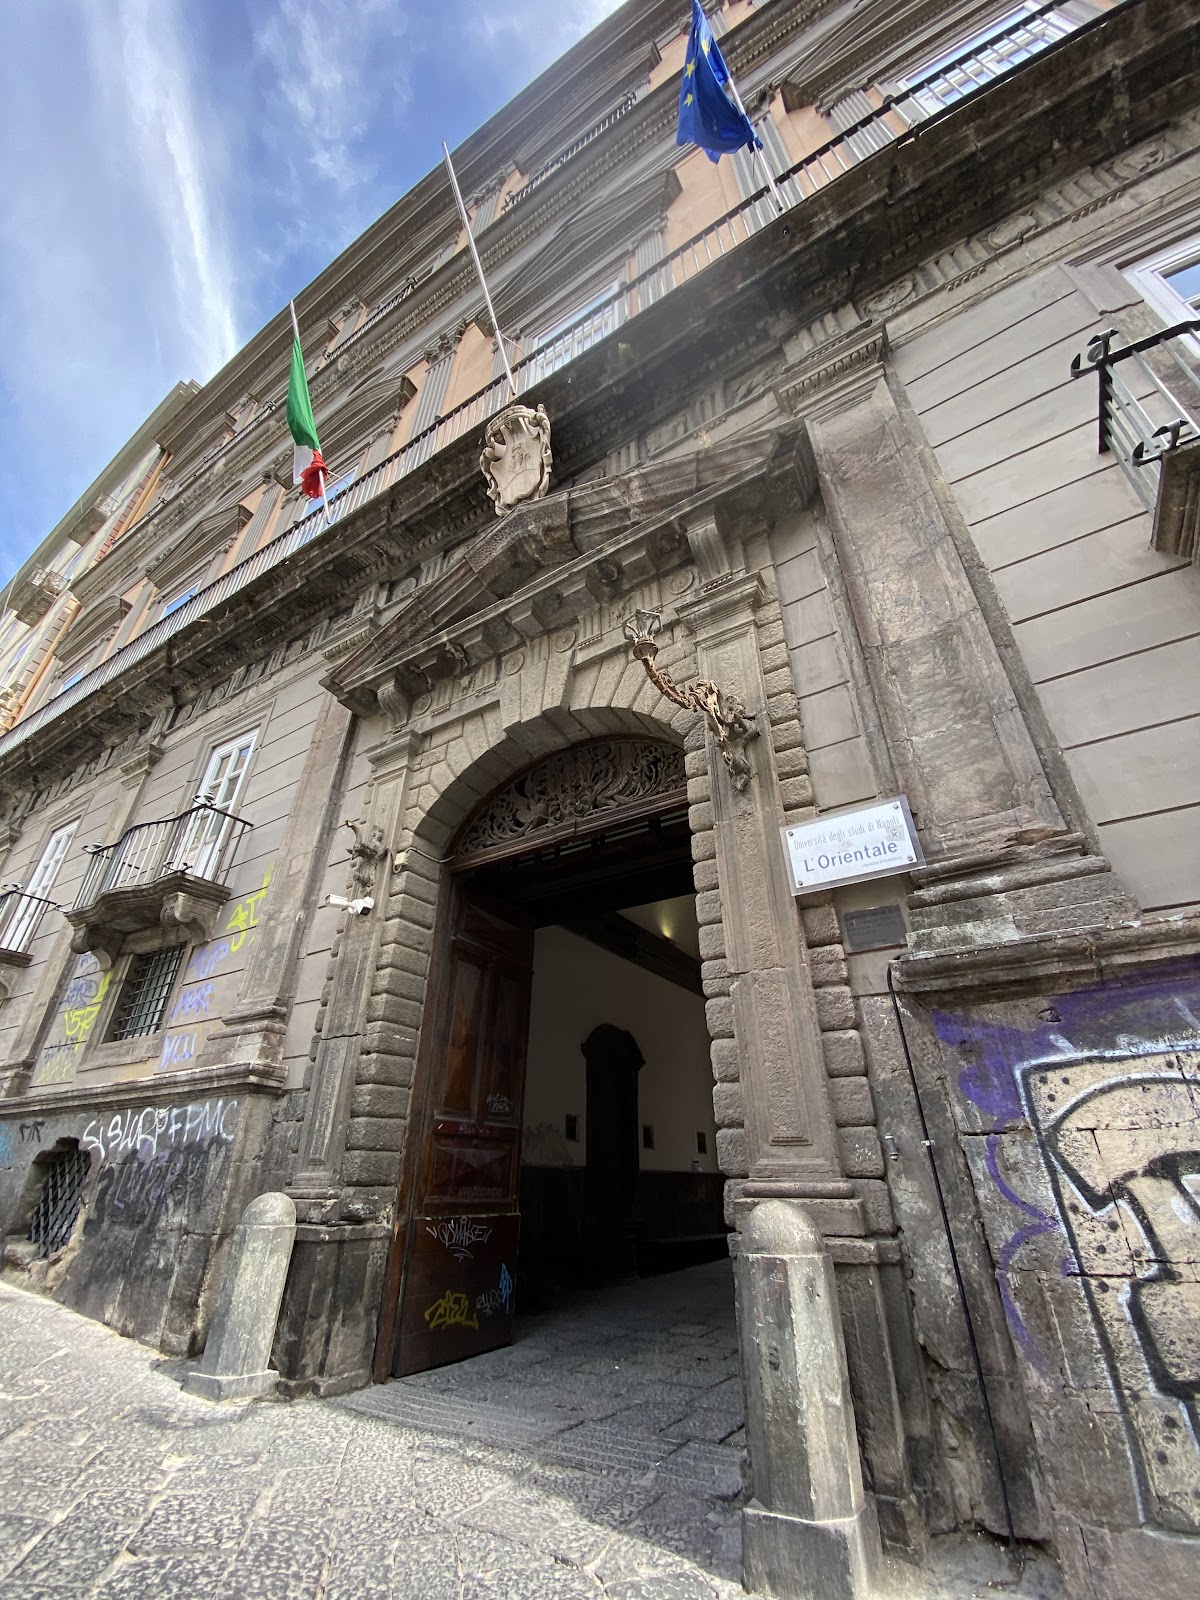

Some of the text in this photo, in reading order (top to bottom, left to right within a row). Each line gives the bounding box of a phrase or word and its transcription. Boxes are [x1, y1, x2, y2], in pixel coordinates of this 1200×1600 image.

[829, 828, 846, 843] degli
[867, 821, 875, 832] di
[876, 815, 900, 833] Napoli
[804, 841, 898, 872] L'Orientale
